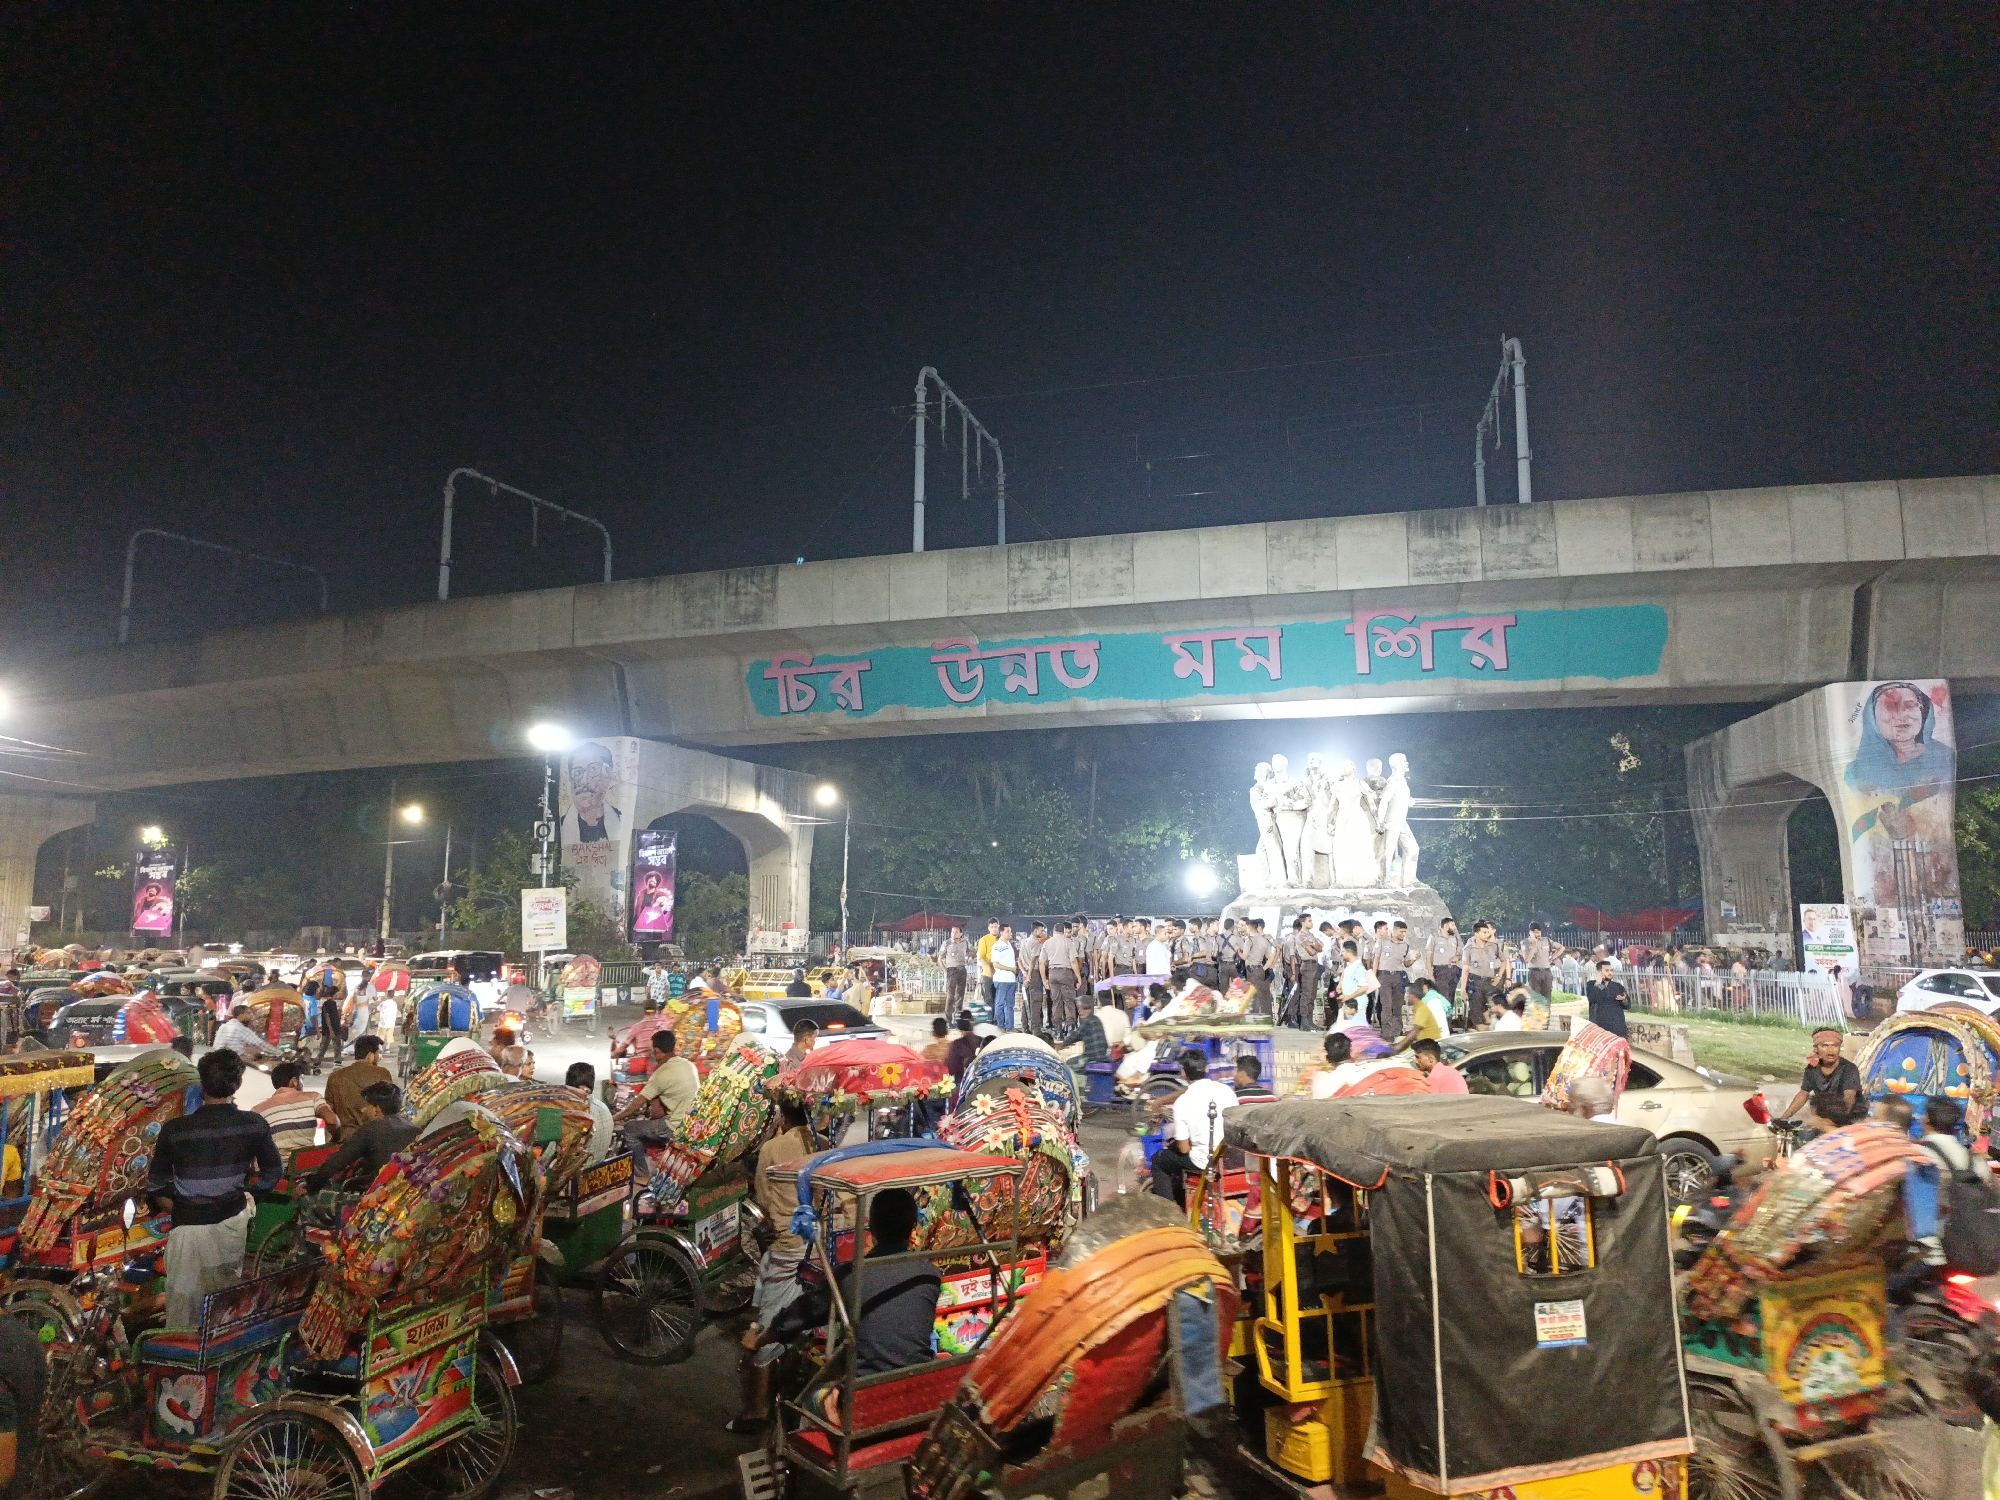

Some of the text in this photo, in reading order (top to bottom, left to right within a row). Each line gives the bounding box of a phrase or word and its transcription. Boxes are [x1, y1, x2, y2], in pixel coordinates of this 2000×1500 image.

[763, 608, 1517, 714] চির উন্নত মম শির
[961, 1278, 979, 1297] দুই
[406, 1313, 450, 1344] হালিমা
